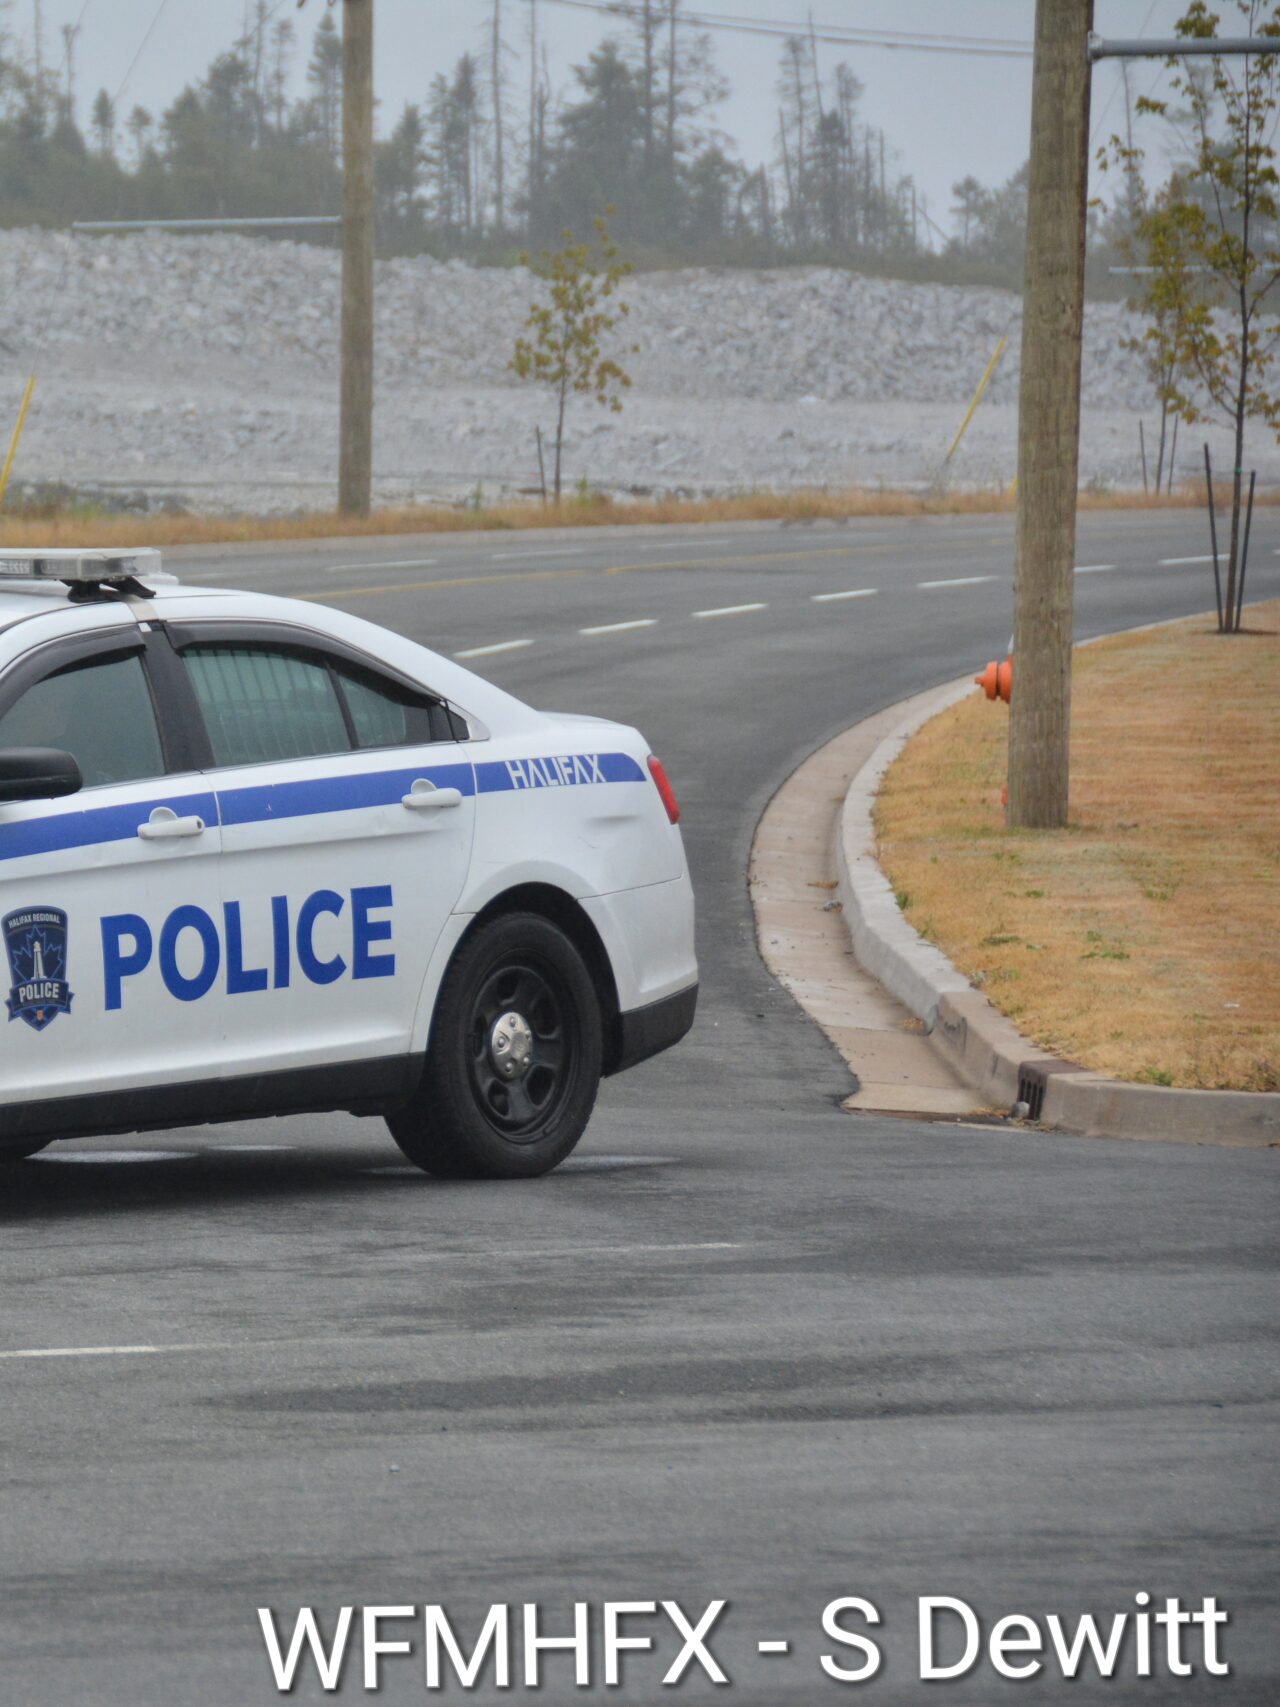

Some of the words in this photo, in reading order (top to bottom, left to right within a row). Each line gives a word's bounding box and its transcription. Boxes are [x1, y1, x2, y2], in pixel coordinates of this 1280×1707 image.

[505, 755, 606, 789] HALIFAX
[8, 915, 32, 928] HALIFAX
[33, 913, 60, 923] REGIONAL
[100, 884, 396, 1011] POLICE
[19, 982, 59, 1002] POLICE
